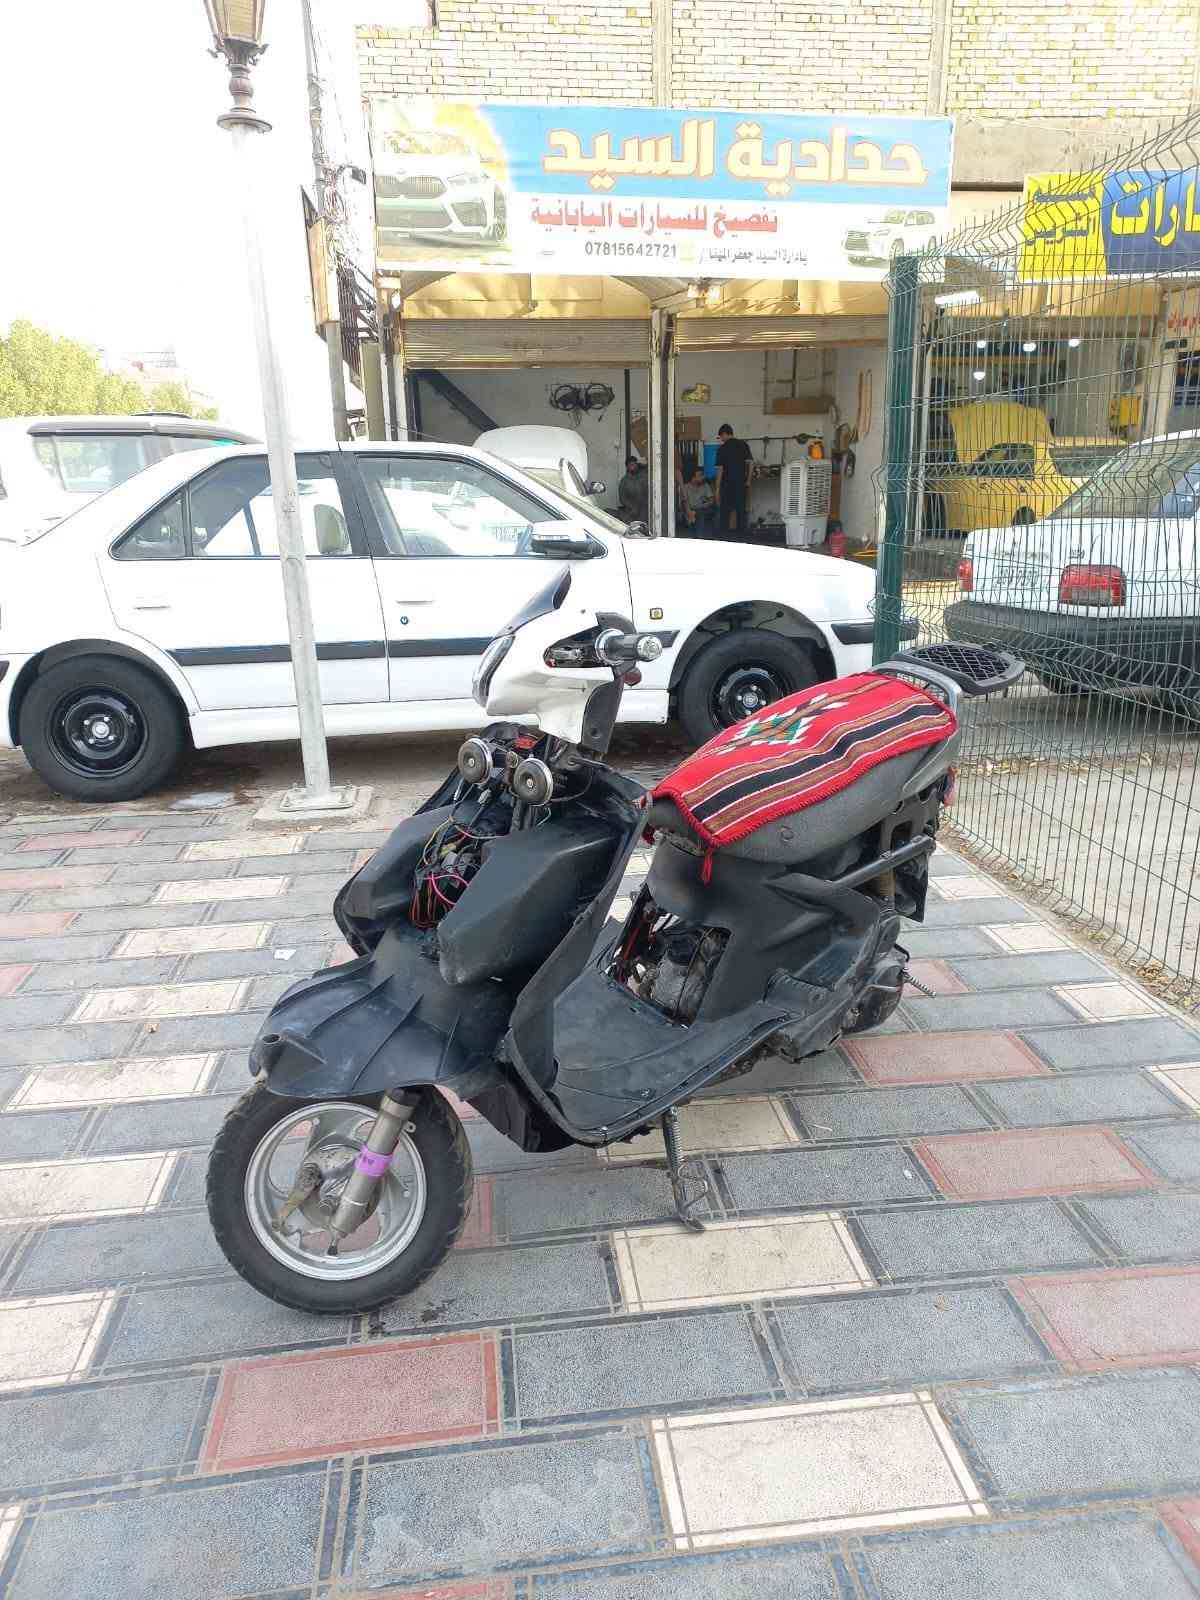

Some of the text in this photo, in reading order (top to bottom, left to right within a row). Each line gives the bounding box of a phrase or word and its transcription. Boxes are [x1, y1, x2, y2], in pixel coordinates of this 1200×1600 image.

[543, 118, 929, 196] حدادية السيد
[531, 197, 613, 233] اليابانية
[619, 200, 708, 236] للسيارات
[585, 240, 678, 258] 07815642721
